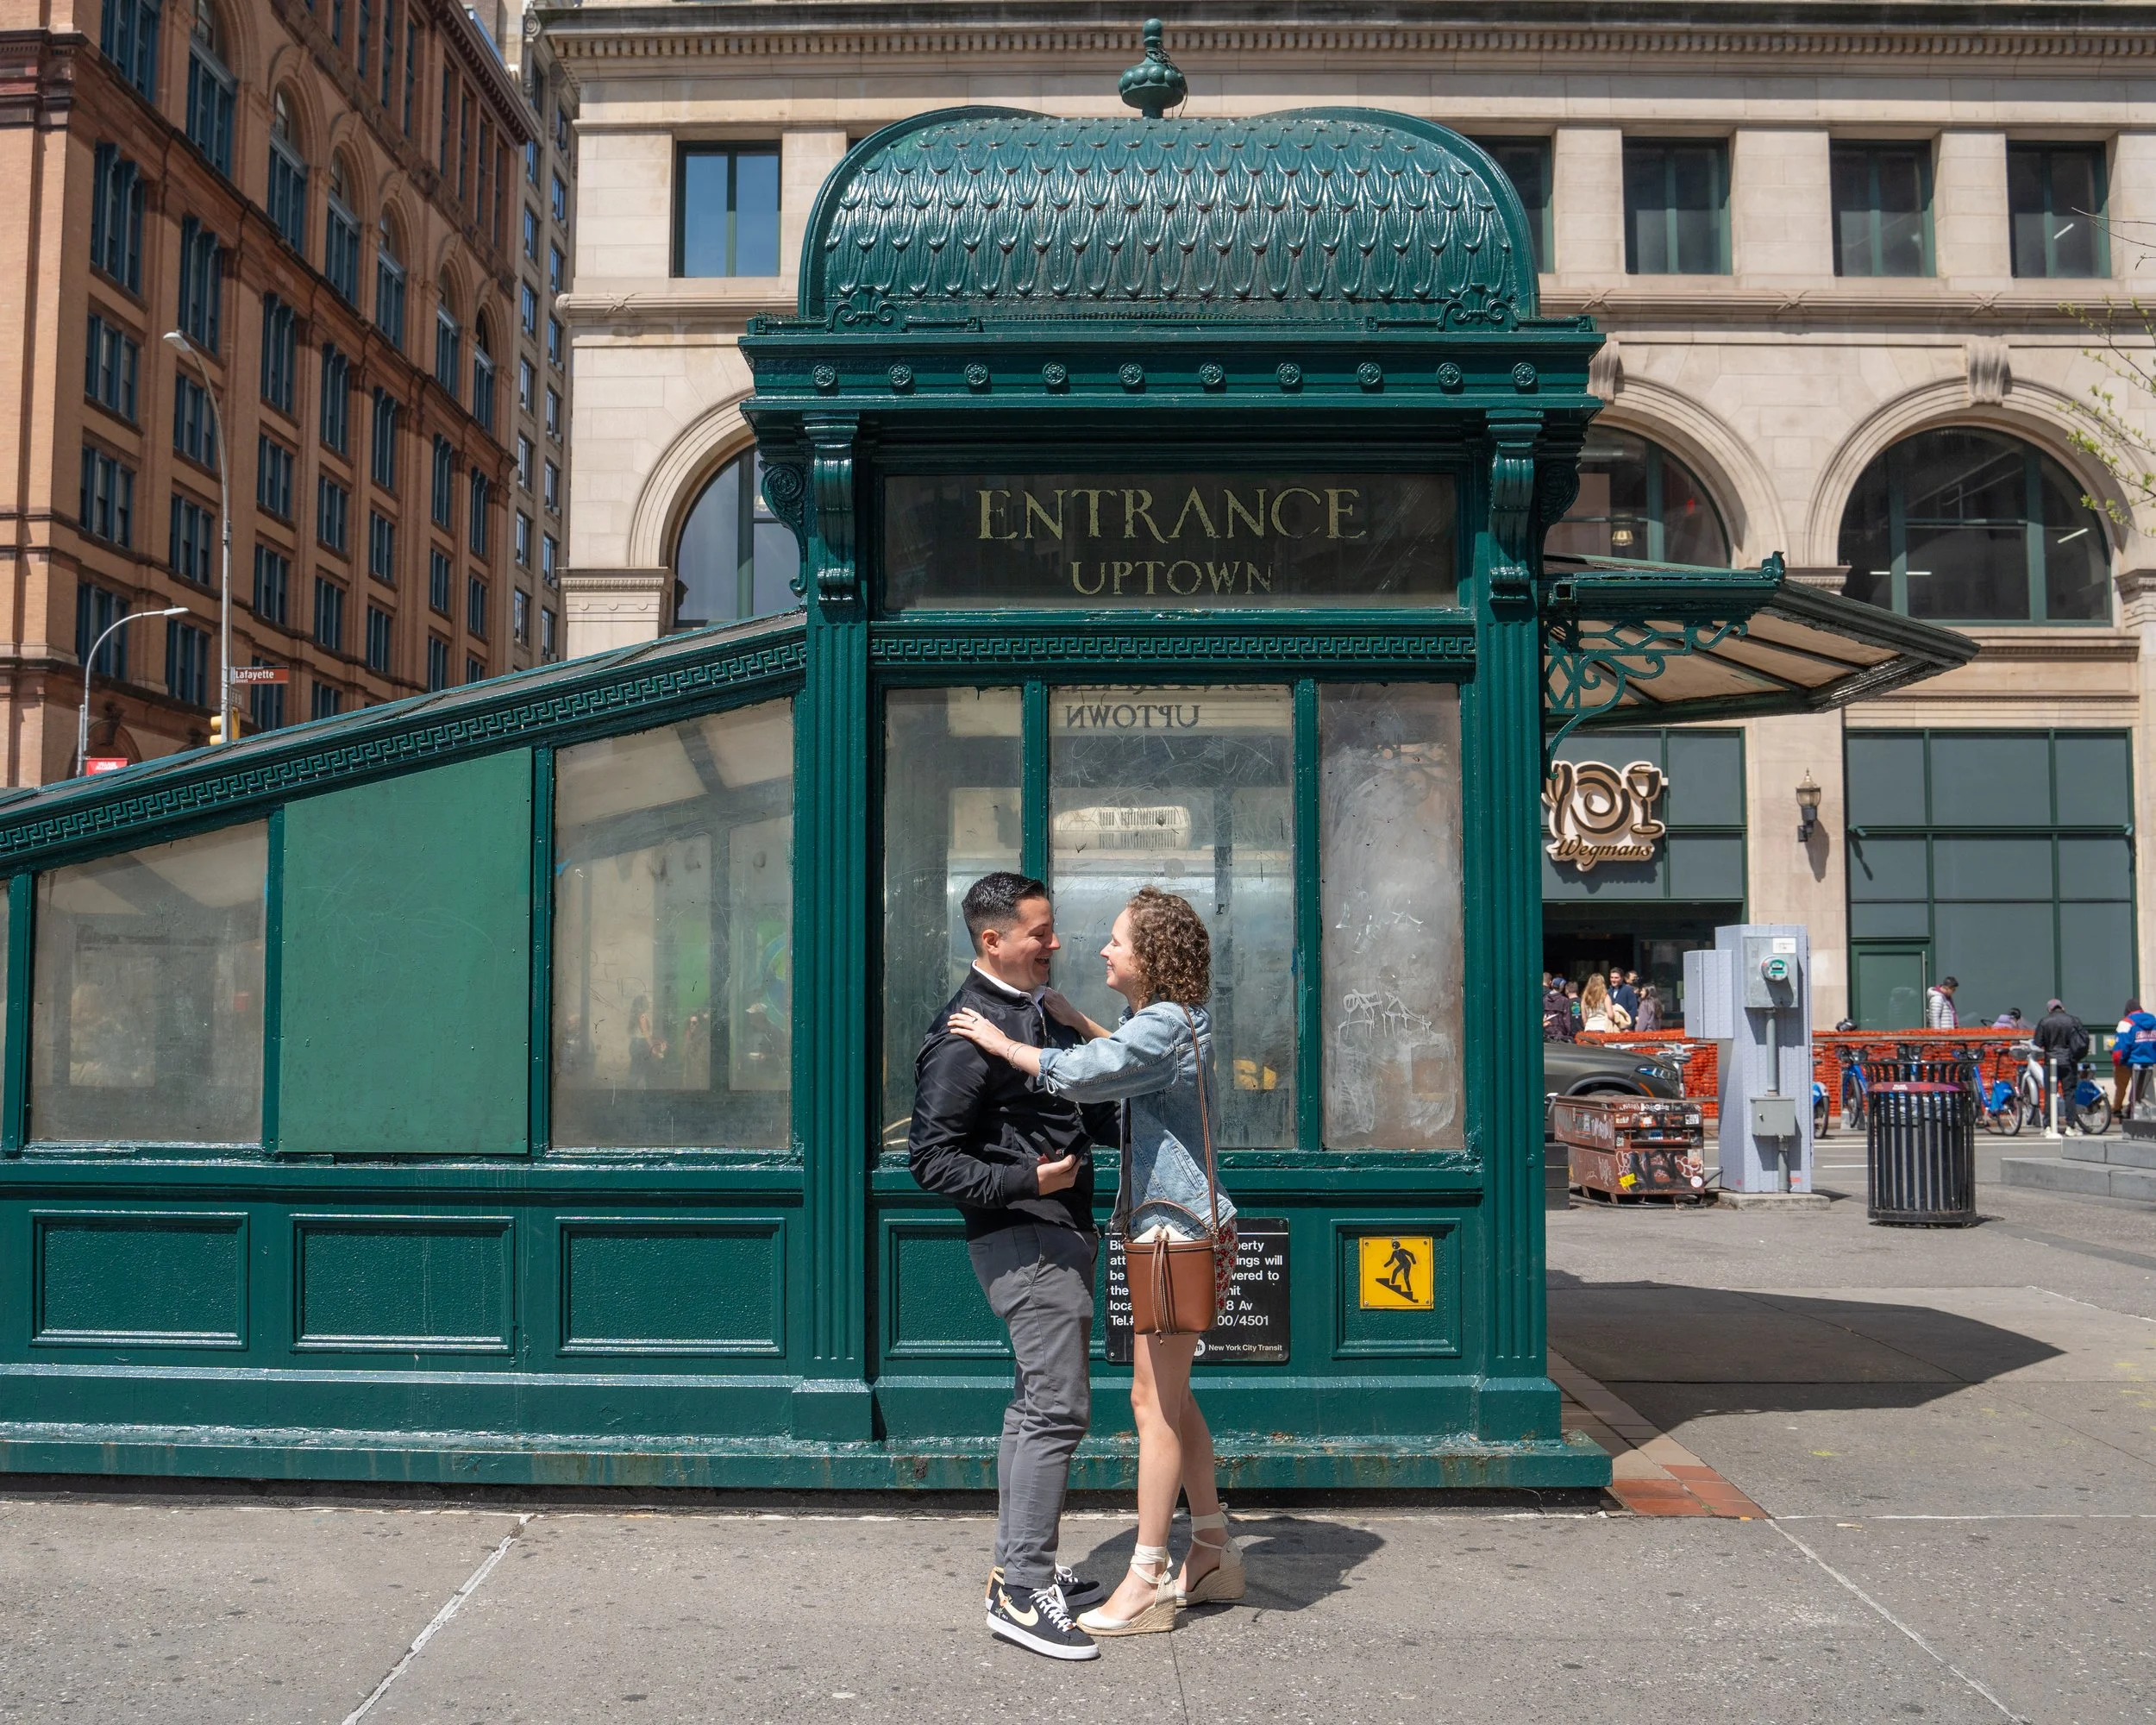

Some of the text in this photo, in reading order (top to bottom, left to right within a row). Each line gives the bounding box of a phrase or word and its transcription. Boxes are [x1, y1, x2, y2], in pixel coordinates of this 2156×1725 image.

[975, 486, 1367, 544] ENTRANCE
[1070, 560, 1273, 595] UPTOWN
[235, 669, 274, 681] Lafayette
[1552, 834, 1652, 866] Wegmans
[1264, 1255, 1283, 1265] will
[1109, 1270, 1125, 1281] be
[1268, 1270, 1280, 1281] to
[1110, 1285, 1129, 1295] the
[1225, 1300, 1234, 1311] 8
[1238, 1300, 1253, 1311] Av
[1242, 1344, 1257, 1352] City
